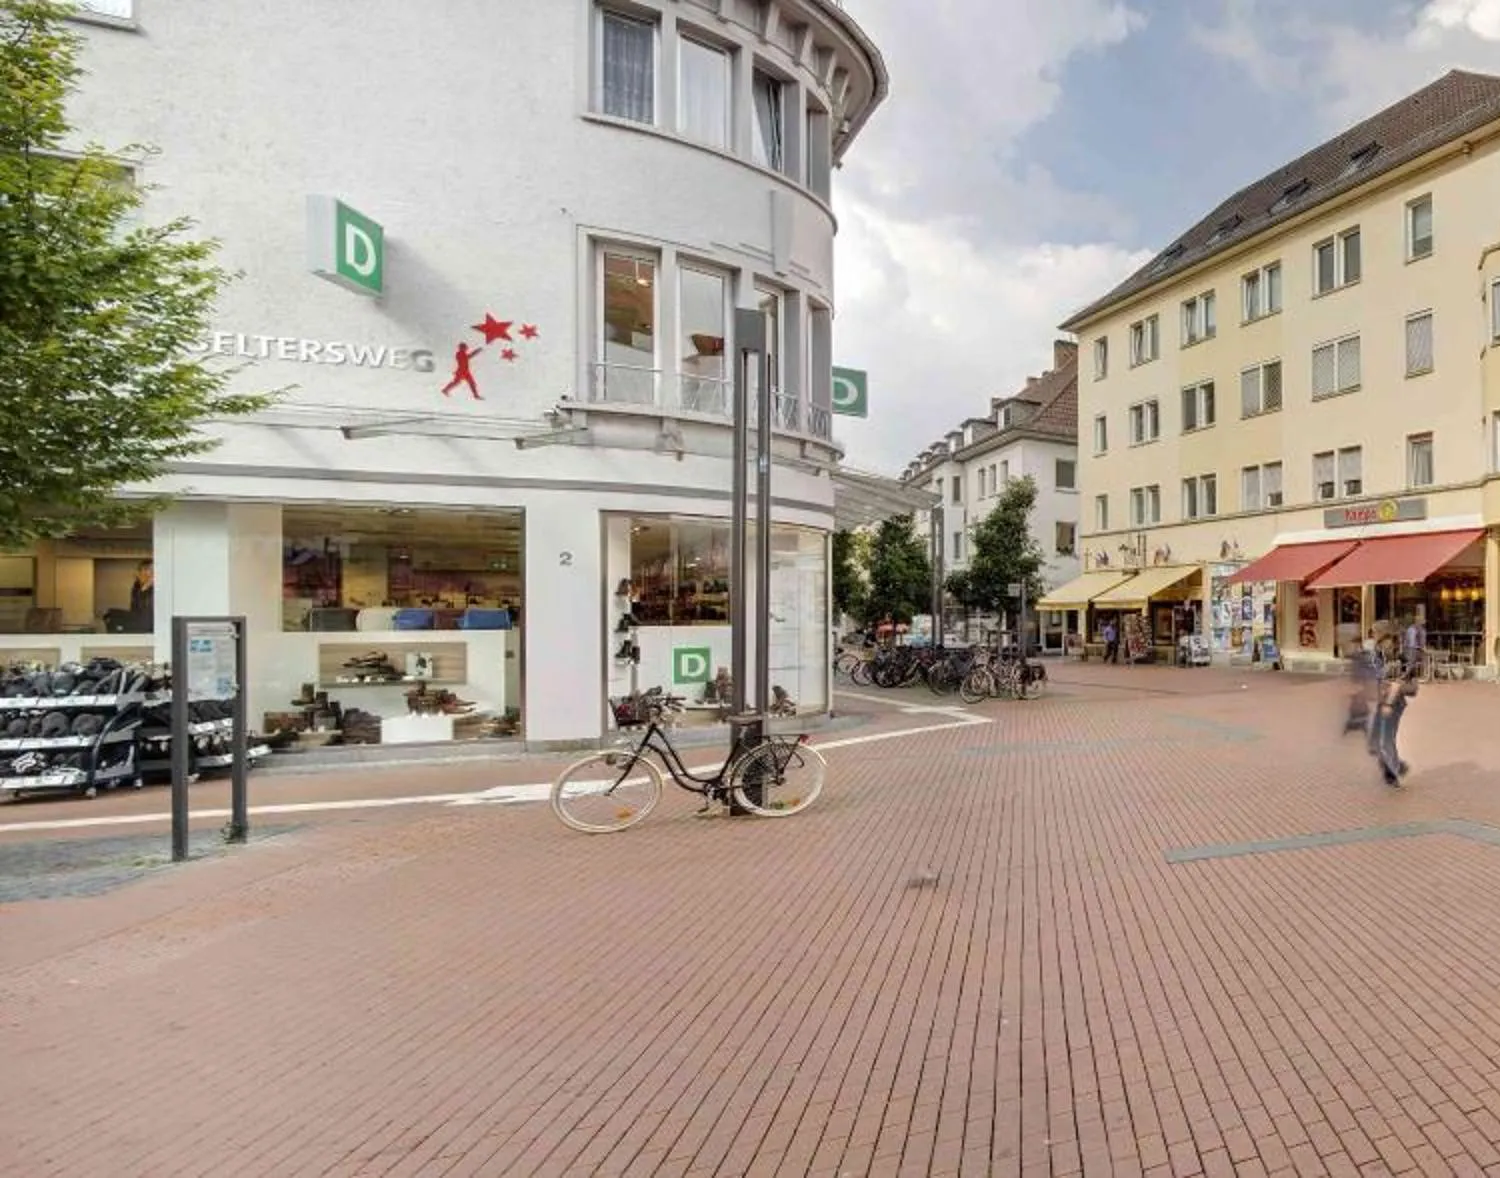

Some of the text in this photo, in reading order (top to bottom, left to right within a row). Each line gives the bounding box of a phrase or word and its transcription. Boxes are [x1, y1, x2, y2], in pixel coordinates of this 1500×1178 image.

[345, 222, 377, 276] D
[832, 376, 859, 405] D
[559, 551, 573, 566] 2
[680, 653, 708, 677] D
